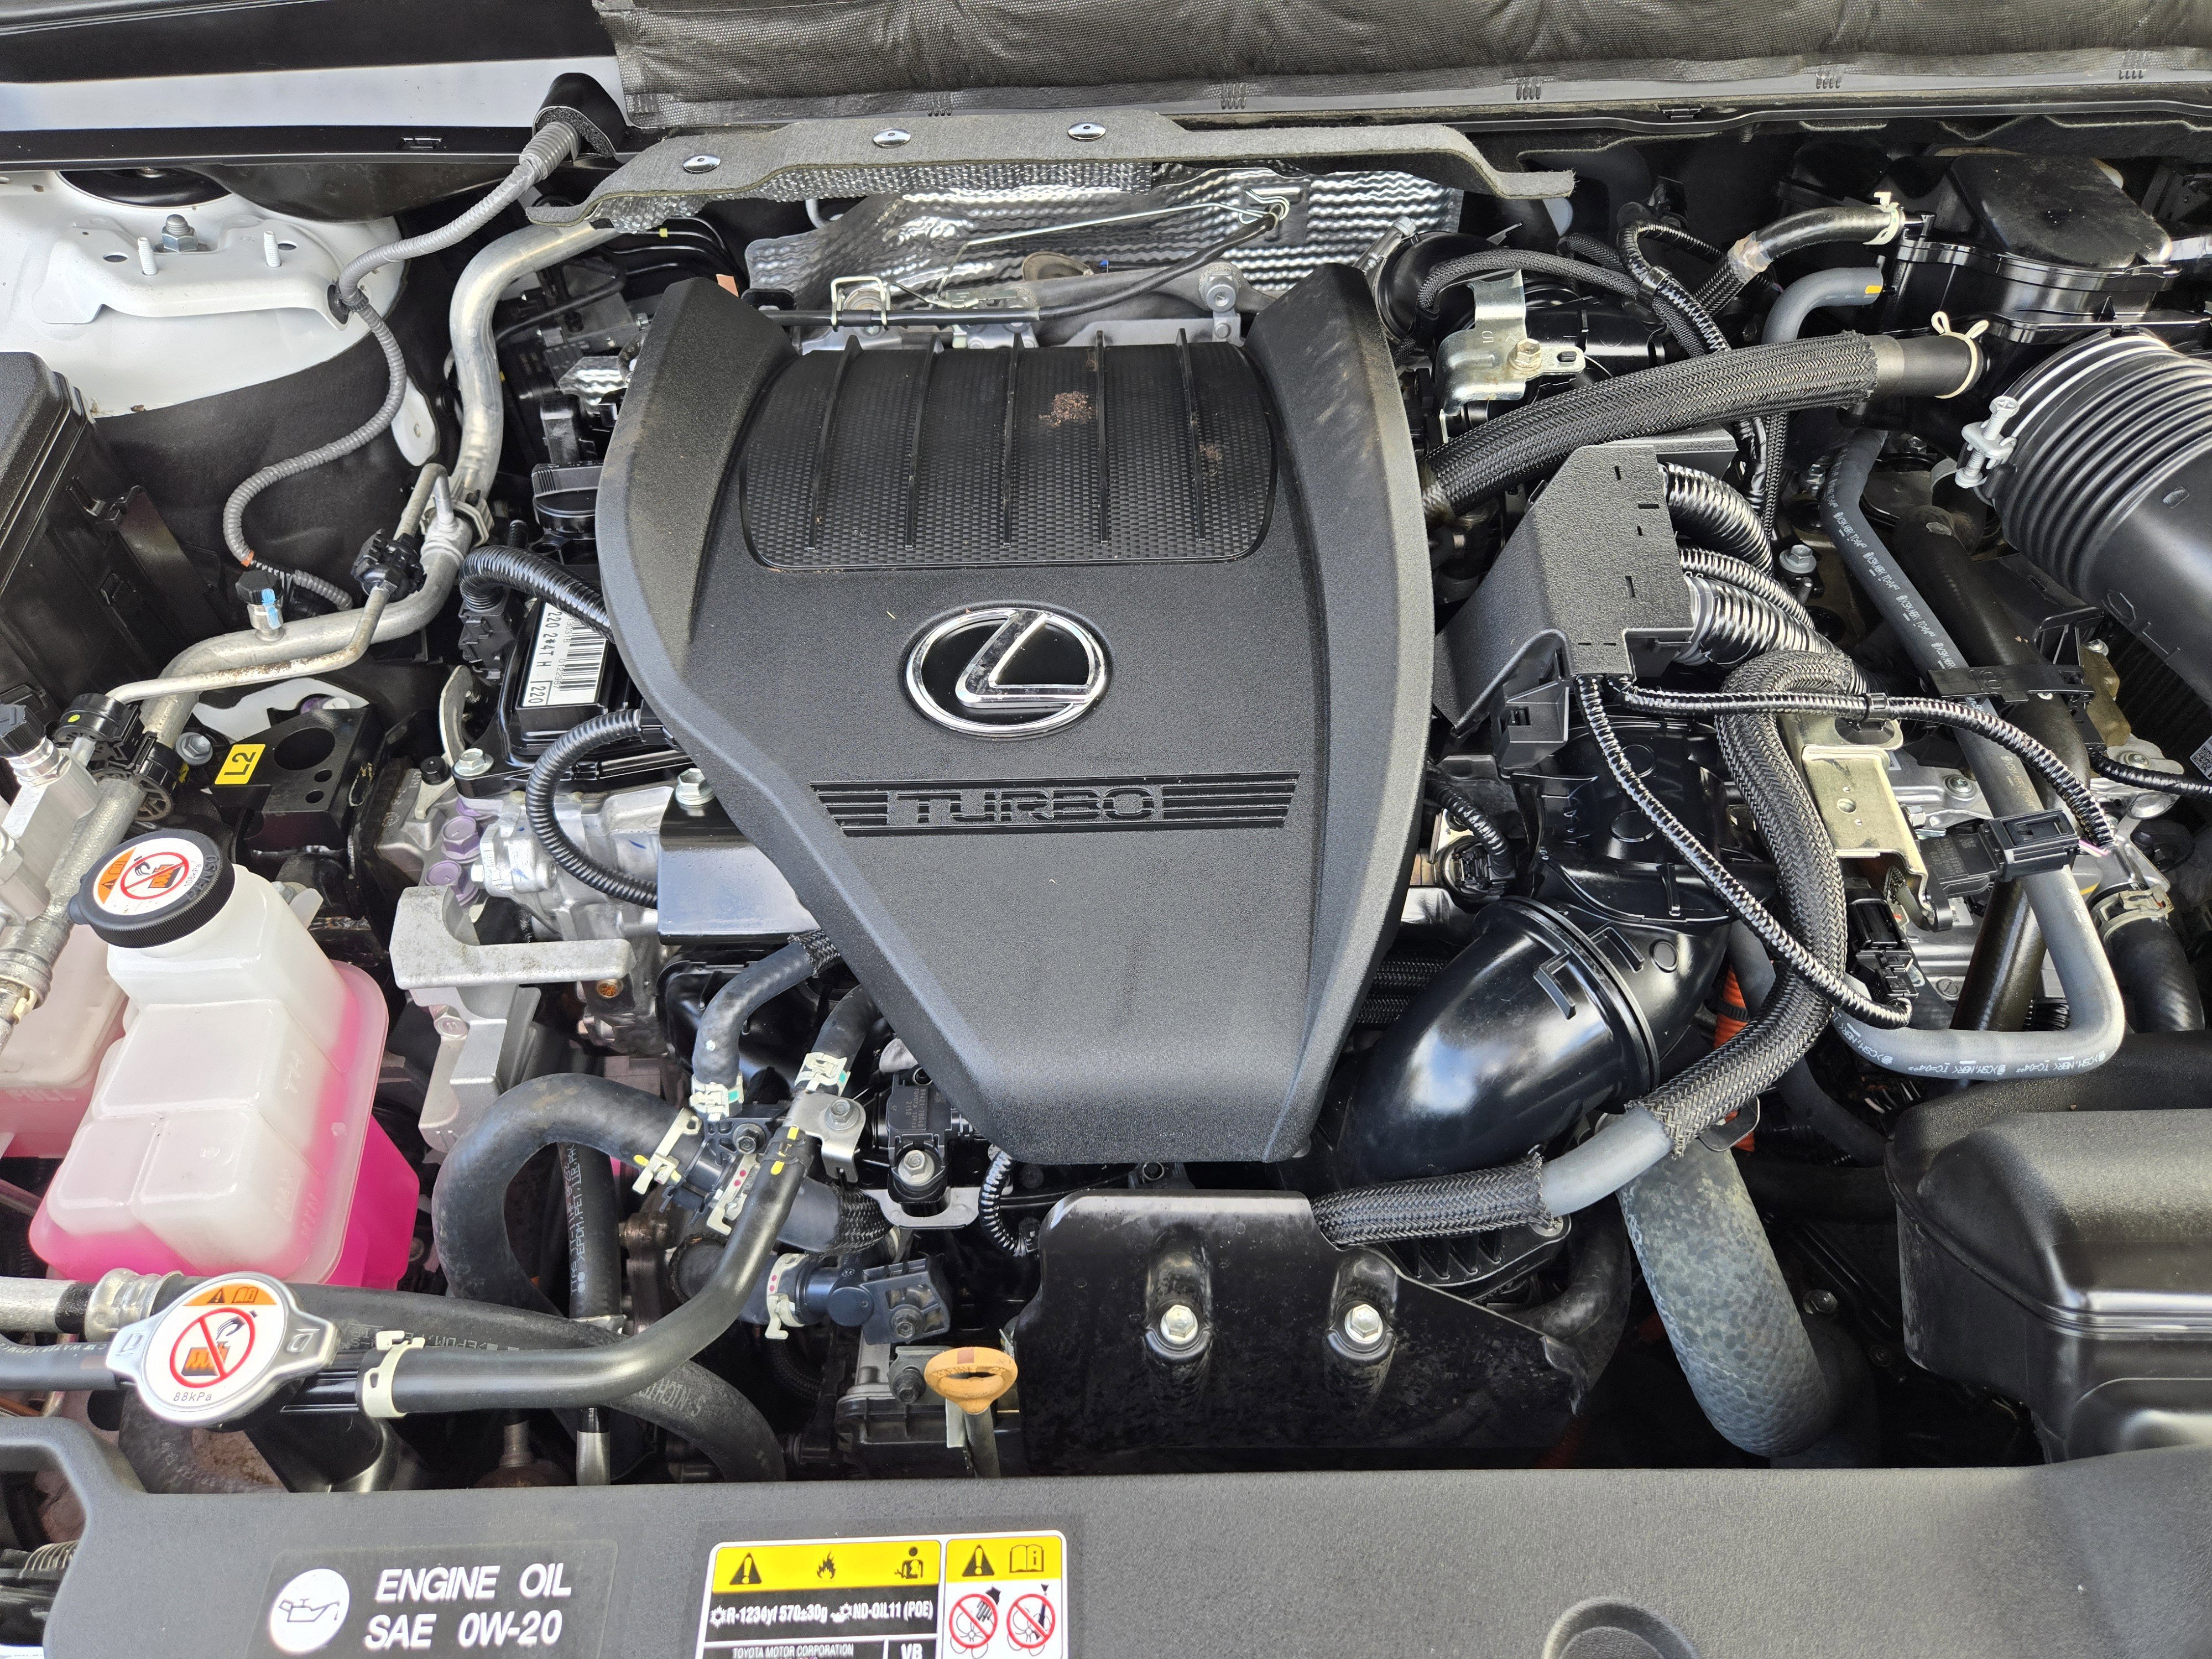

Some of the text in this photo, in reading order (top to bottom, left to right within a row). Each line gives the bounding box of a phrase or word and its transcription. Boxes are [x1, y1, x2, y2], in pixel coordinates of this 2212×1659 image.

[545, 612, 563, 628] 220
[528, 686, 546, 703] 220
[223, 752, 257, 776] L2
[897, 786, 1155, 823] TURBO
[184, 863, 202, 886] 108kPa
[185, 855, 219, 901] DENSO
[173, 1391, 212, 1402] 88kPa
[375, 1563, 571, 1603] ENGINE OIL
[852, 1600, 933, 1622] ND-OIL11 (POE)
[364, 1610, 562, 1651] SAE 0W-20
[732, 1644, 854, 1658] TOYOTA MOTOR CORPORATION
